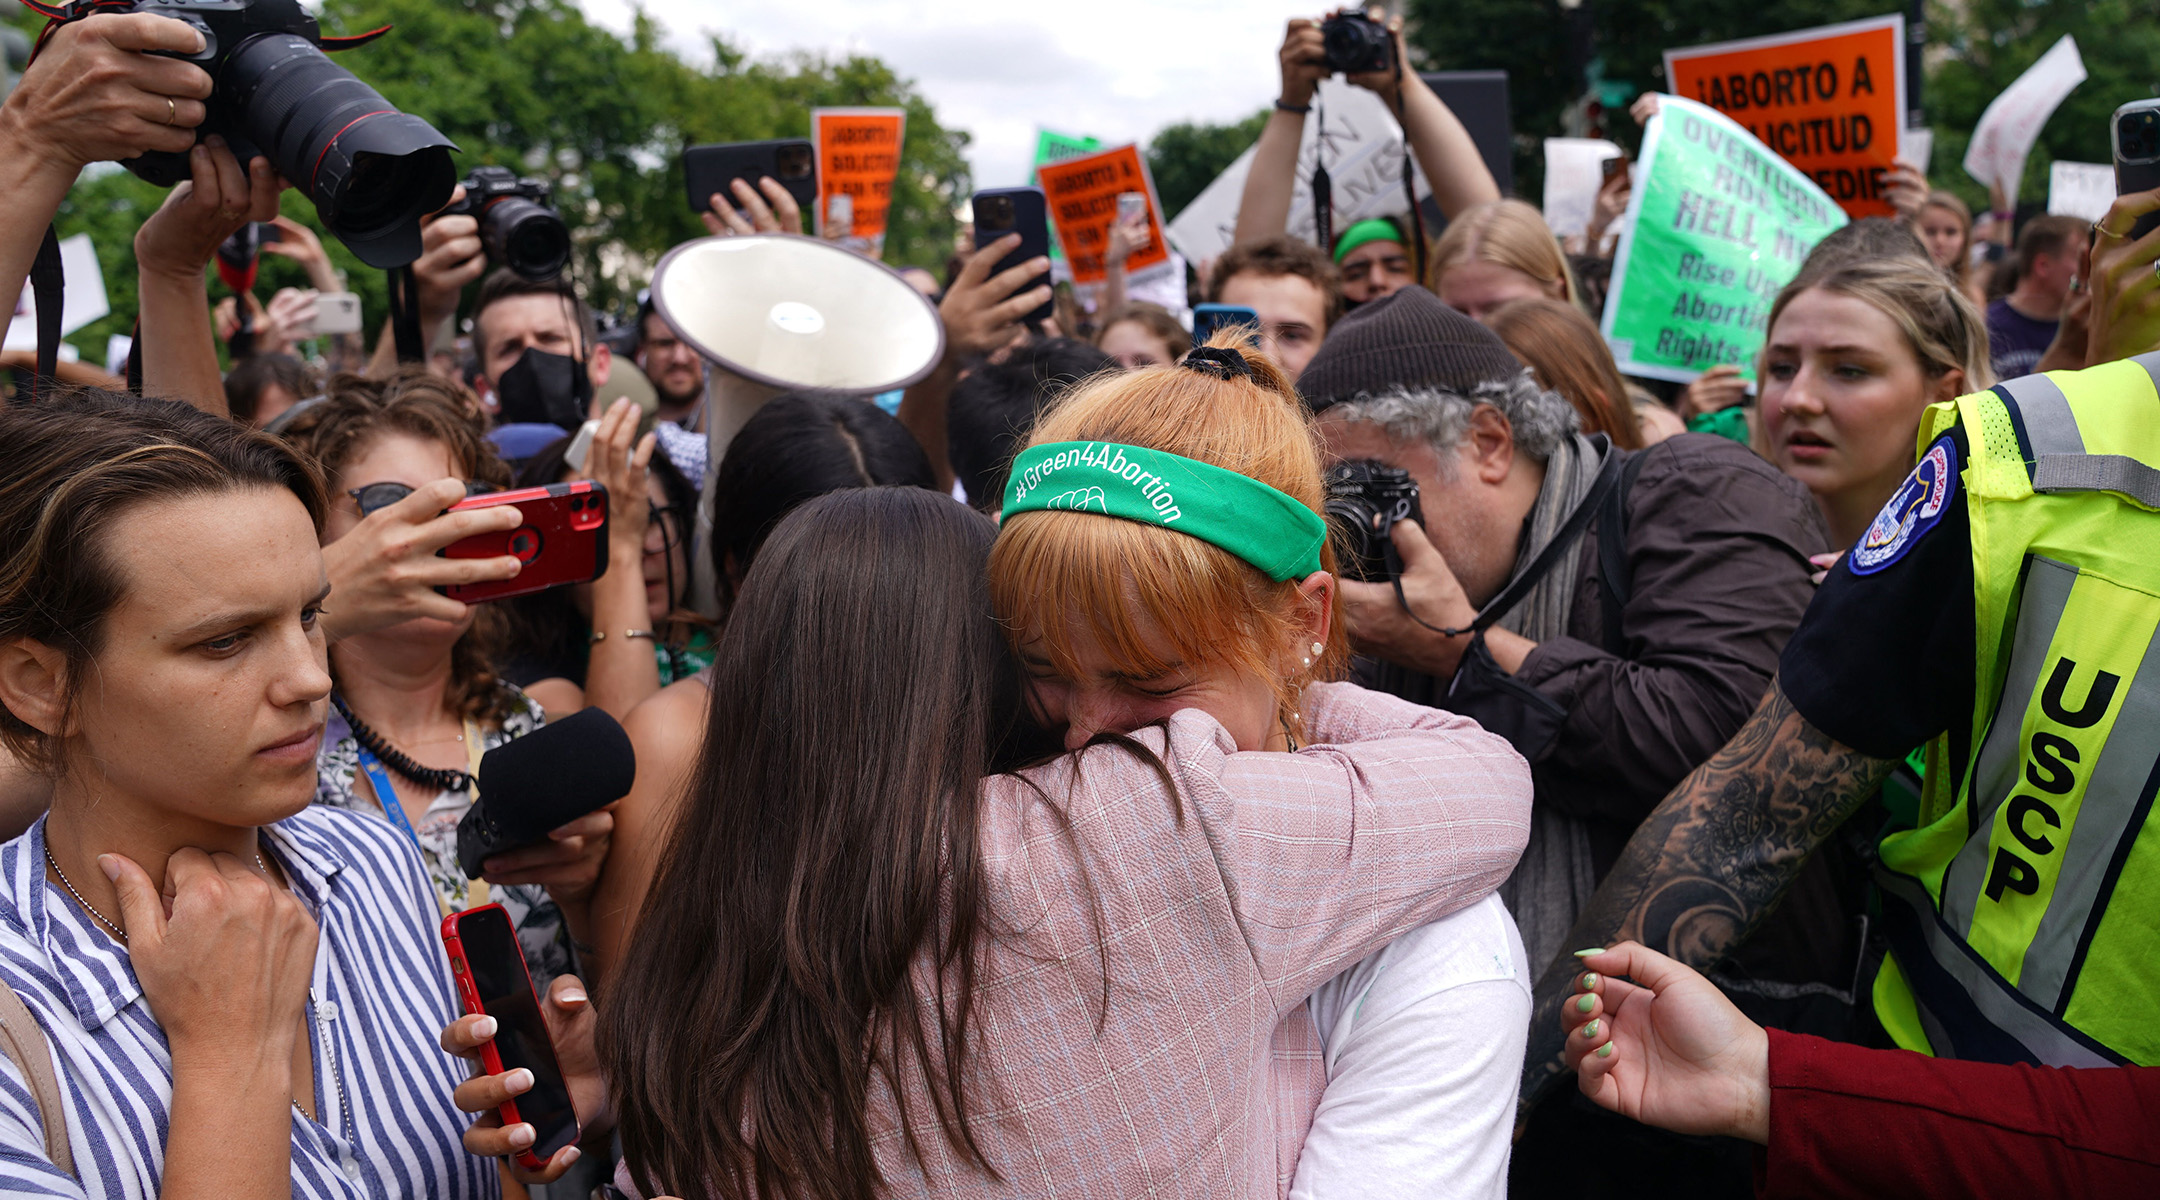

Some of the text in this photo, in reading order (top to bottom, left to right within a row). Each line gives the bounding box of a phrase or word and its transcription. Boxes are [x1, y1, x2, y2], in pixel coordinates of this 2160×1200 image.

[1851, 55, 1875, 97] A
[1673, 189, 1758, 249] HELL
[1677, 252, 1736, 289] Rise
[1015, 441, 1183, 525] #Green4Abortion
[1984, 656, 2121, 904] USCP
